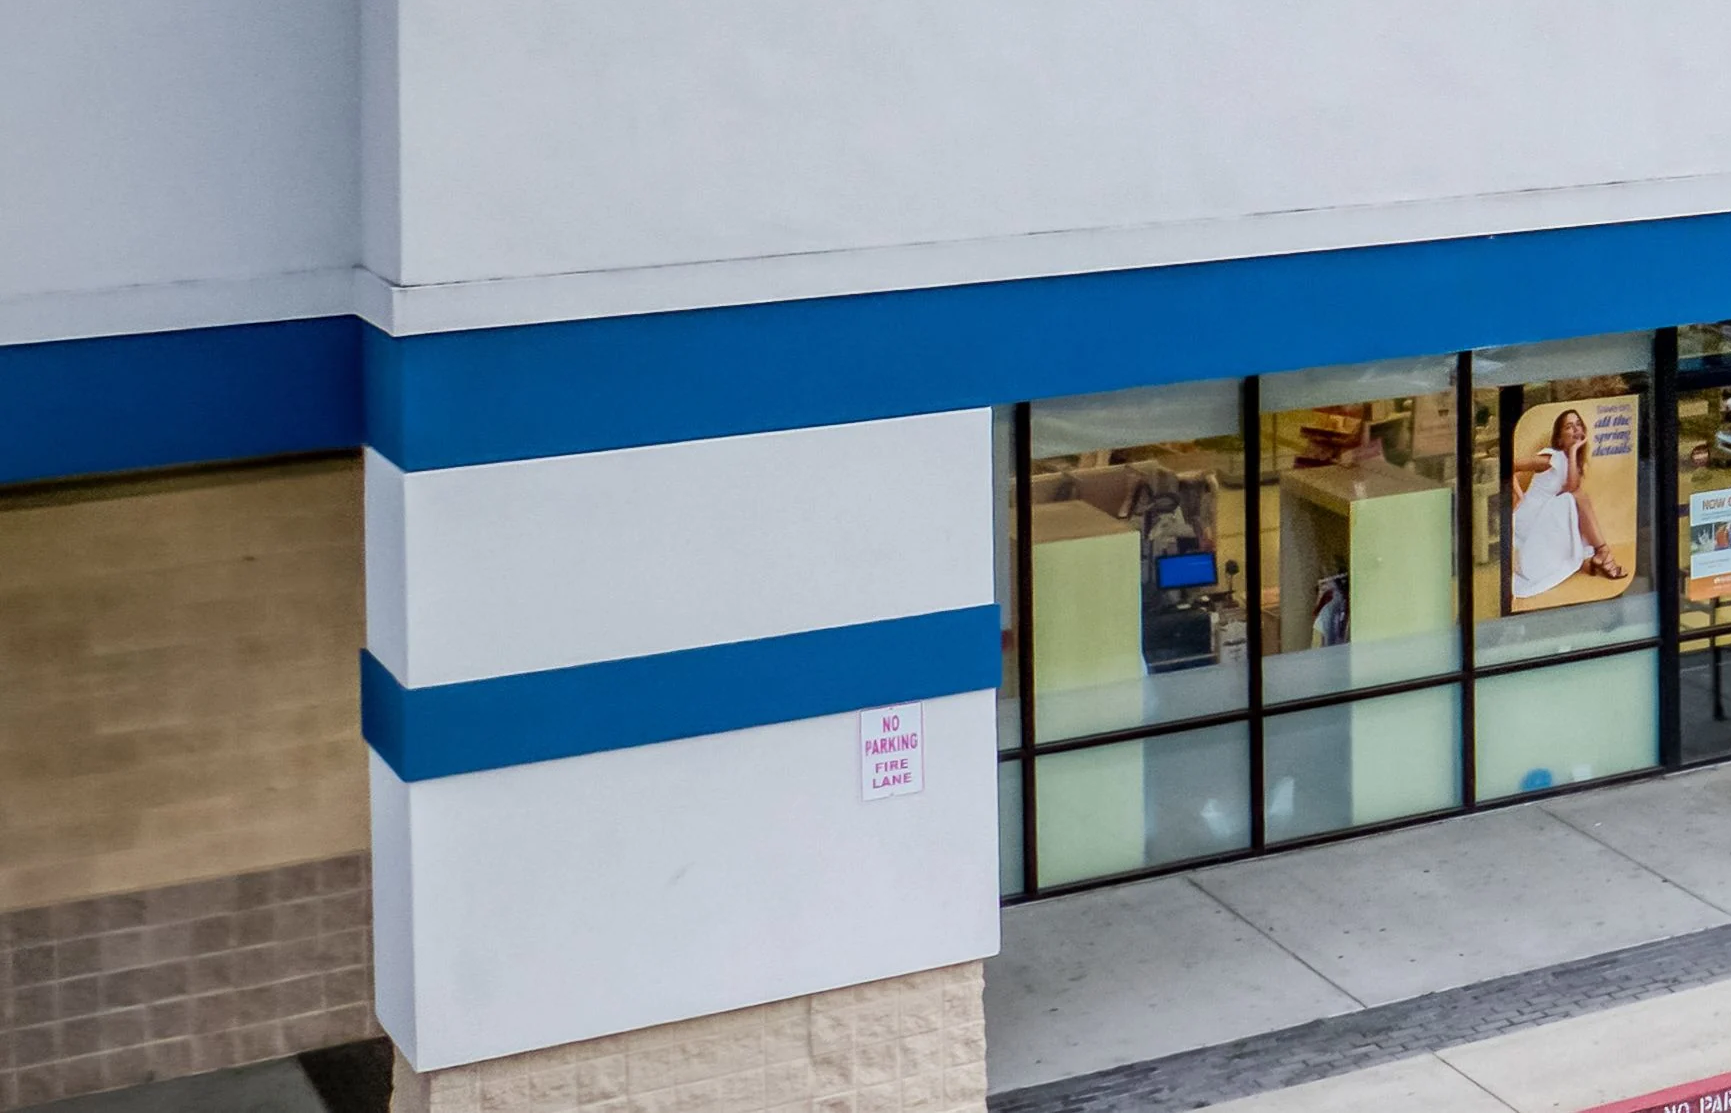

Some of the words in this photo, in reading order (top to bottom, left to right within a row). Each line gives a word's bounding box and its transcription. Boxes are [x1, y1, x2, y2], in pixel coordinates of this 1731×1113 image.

[1591, 444, 1632, 457] details
[1702, 498, 1726, 511] NOW
[882, 714, 900, 733] NO
[865, 733, 918, 757] PARKING
[875, 758, 908, 774] FIRE
[872, 772, 912, 789] LANE
